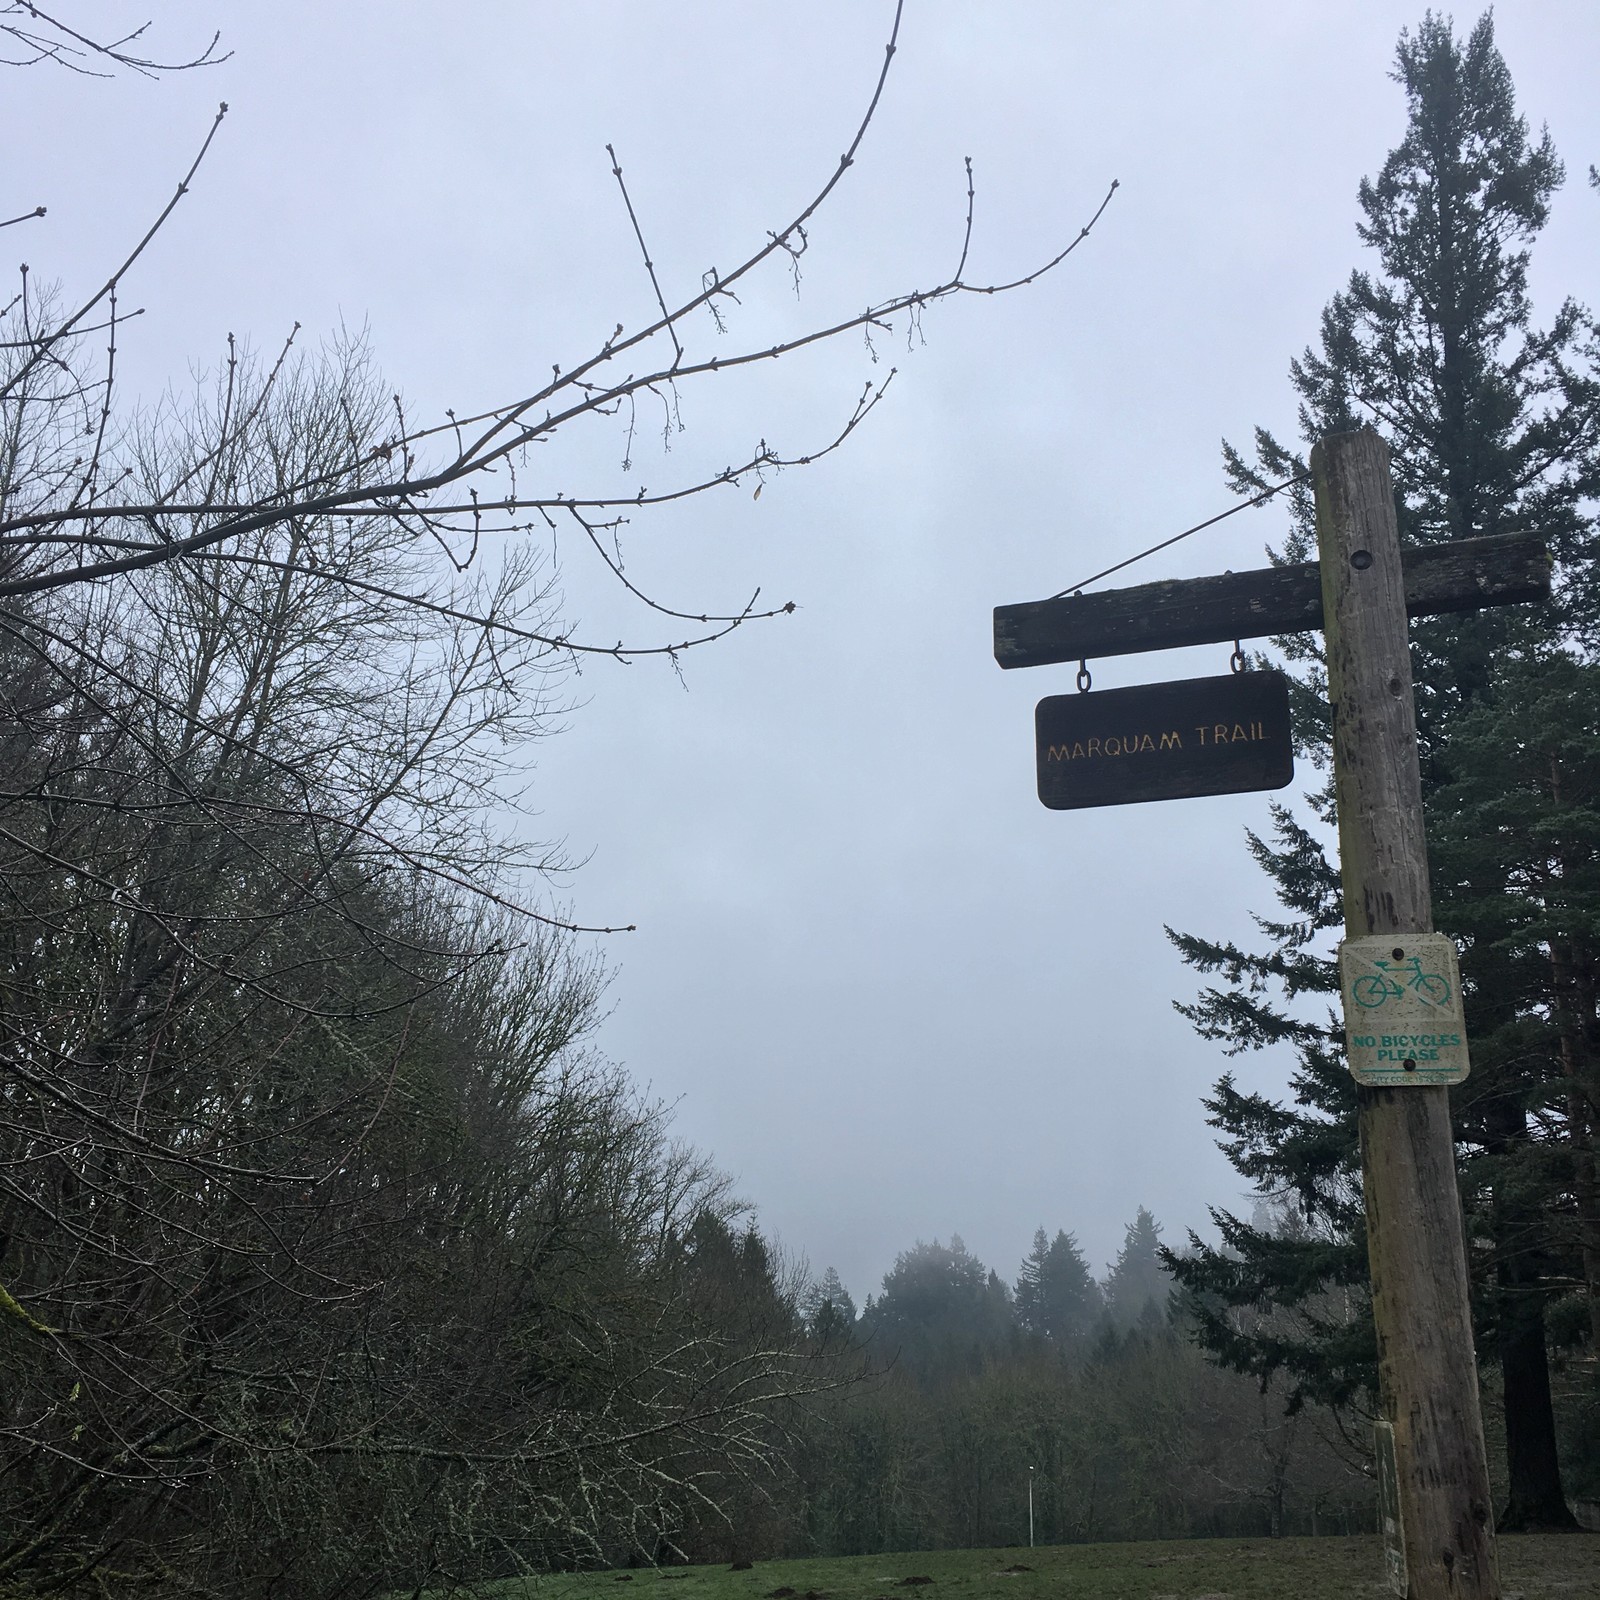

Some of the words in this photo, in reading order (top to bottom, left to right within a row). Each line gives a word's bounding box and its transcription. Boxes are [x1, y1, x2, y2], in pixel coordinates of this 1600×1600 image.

[1047, 731, 1183, 762] MARQUAM
[1196, 722, 1271, 745] TRAIL
[1353, 1035, 1376, 1048] NO
[1381, 1034, 1461, 1047] BICYCLES
[1377, 1049, 1440, 1061] PLEASE
[1390, 1075, 1412, 1083] CODE
